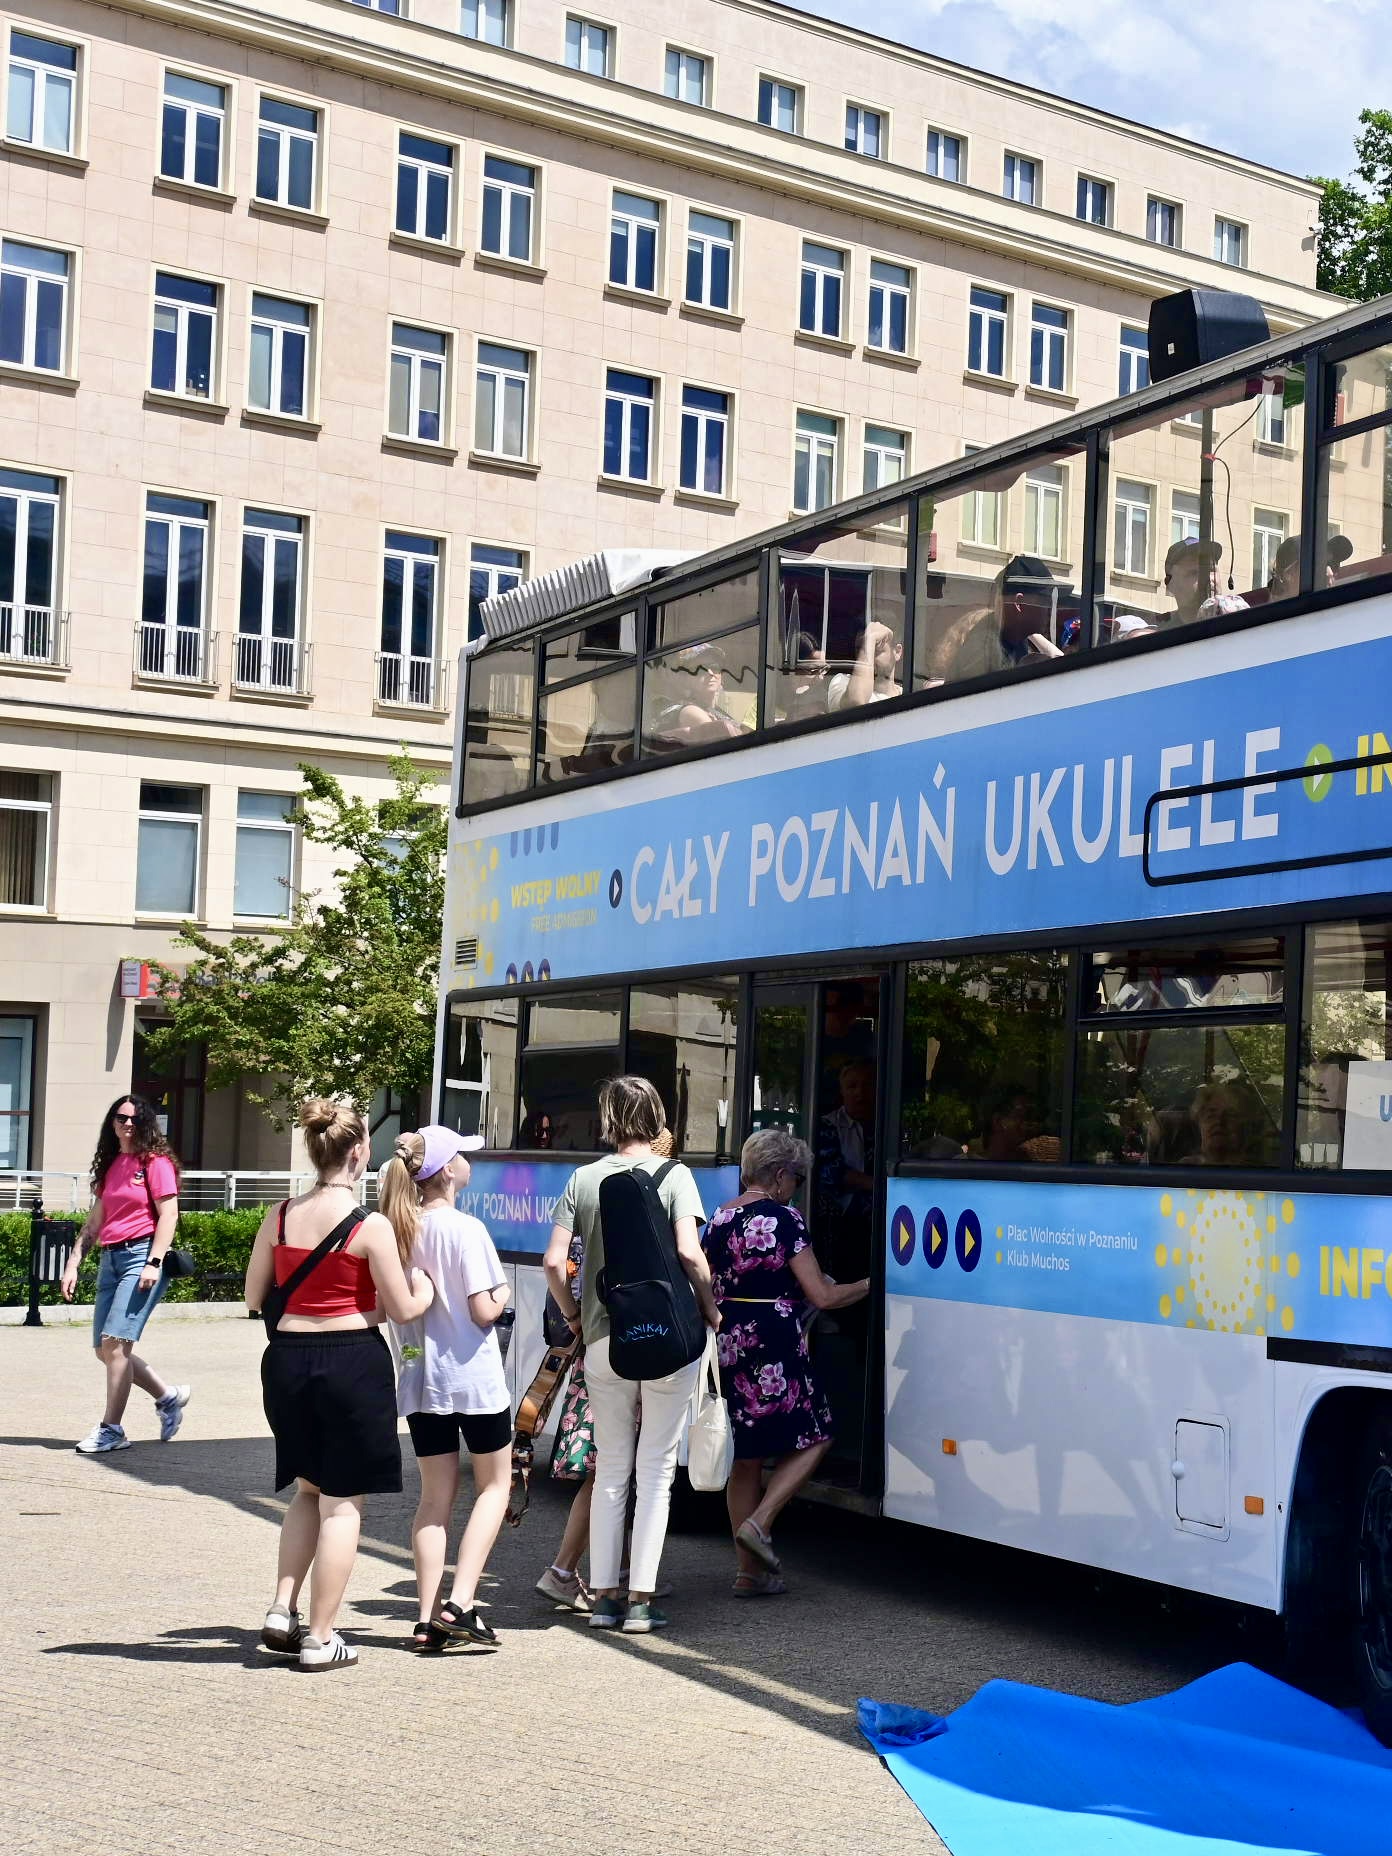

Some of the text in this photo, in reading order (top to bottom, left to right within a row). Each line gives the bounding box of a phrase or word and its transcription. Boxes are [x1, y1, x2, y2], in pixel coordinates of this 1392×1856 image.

[629, 725, 1281, 925] CAŁY POZNAŃ UKULELE
[511, 870, 601, 912] WSTĘP WOLNY
[482, 1184, 531, 1223] POZNAŃ
[1007, 1225, 1138, 1250] Plac Wolności w Poznaniu
[1007, 1250, 1070, 1271] Klub Muchos
